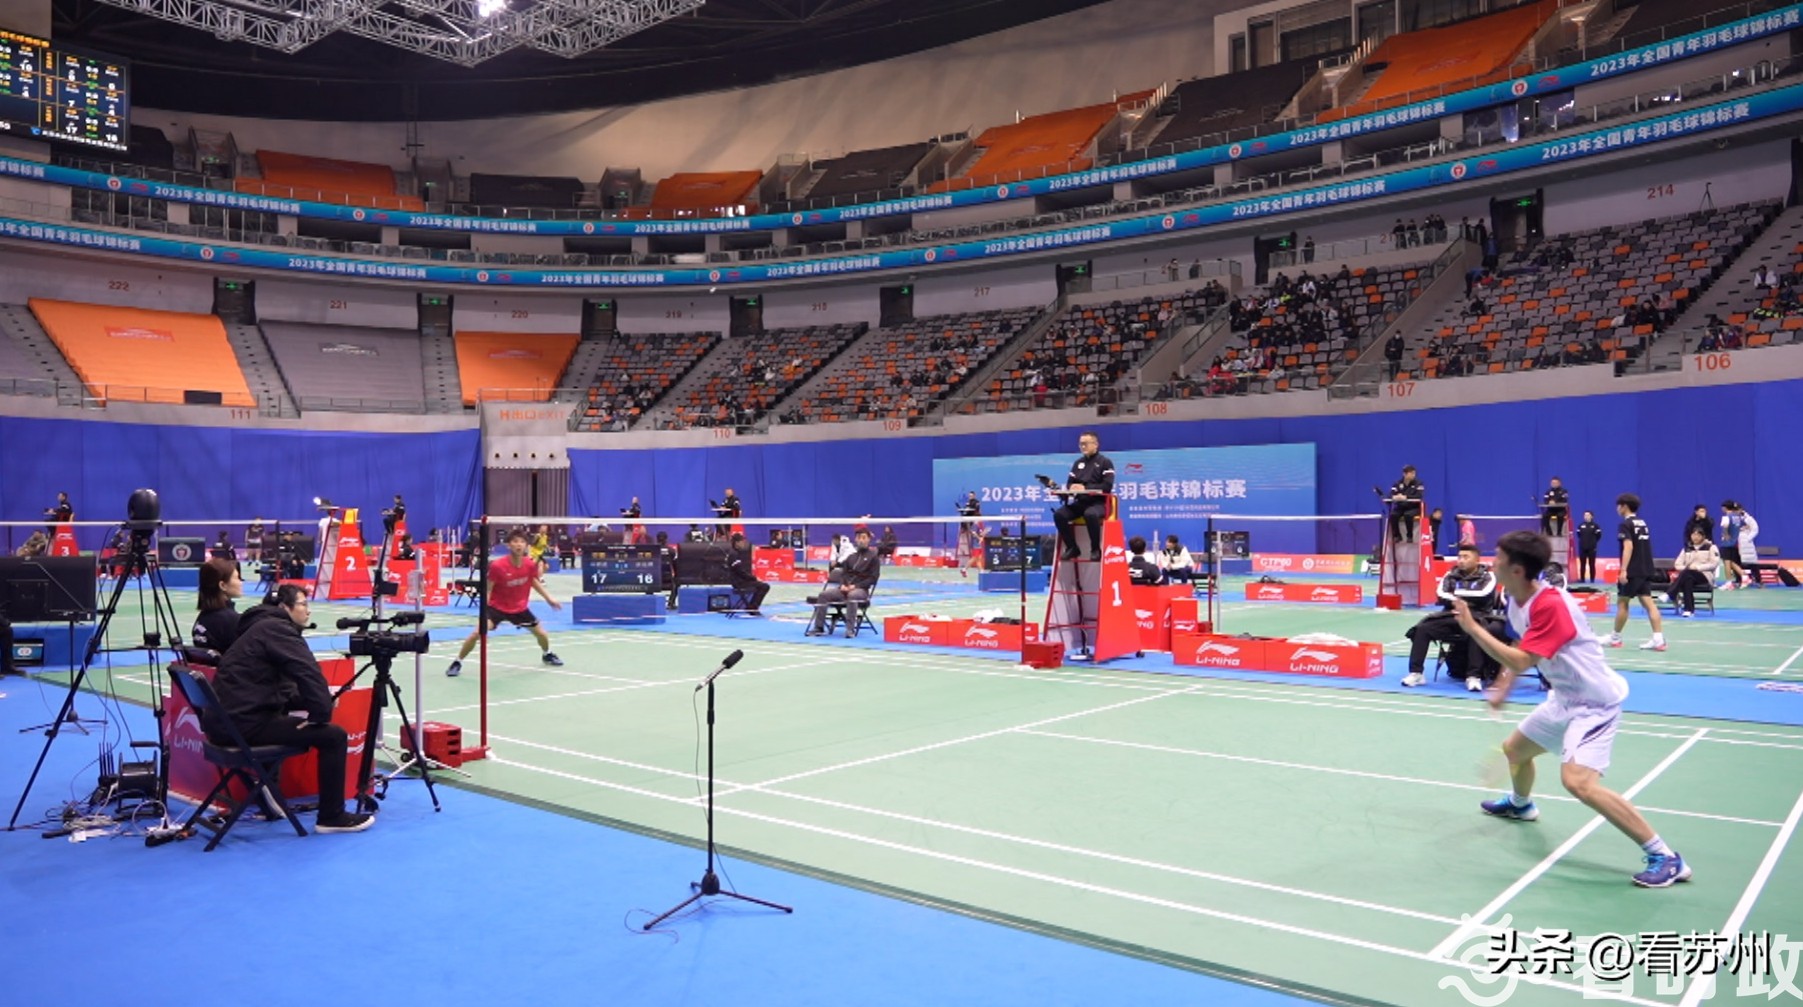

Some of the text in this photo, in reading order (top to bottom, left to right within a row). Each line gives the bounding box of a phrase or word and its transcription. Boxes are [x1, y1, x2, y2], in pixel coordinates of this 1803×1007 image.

[1590, 8, 1800, 77] 2023年全国青年羽毛球锦标赛
[1290, 101, 1446, 145] 2023年全国青年羽毛球锦标赛
[1541, 102, 1750, 160] 2023年全国青年羽毛球锦标赛
[1049, 158, 1177, 189] 2023年全国青年羽毛球锦标赛
[1232, 180, 1386, 216] 2023年全国青年羽毛球锦标赛
[1647, 183, 1675, 199] 214
[154, 186, 300, 213] 2023年全国青年羽毛球锦标赛
[984, 226, 1111, 254] 2023年全国青年羽毛球锦标赛
[288, 258, 427, 279] 2023年全国青年羽毛球锦标赛
[108, 281, 129, 291] 222
[974, 287, 990, 297] 217
[329, 300, 347, 310] 221
[511, 310, 528, 319] 220
[1694, 353, 1731, 371] 106
[1387, 382, 1415, 397] 107
[230, 409, 251, 419] 111
[1145, 403, 1167, 416] 108
[882, 420, 901, 431] 109
[713, 428, 730, 439] 110
[981, 480, 1247, 501] 2023年全羽毛球锦标赛
[345, 556, 356, 571] 2
[1026, 556, 1033, 564] 7
[591, 573, 607, 584] 17
[1111, 580, 1123, 607] 1
[899, 635, 931, 643] LI-NING
[965, 639, 998, 648] LI-NING
[1195, 655, 1241, 667] LI-NING
[1289, 662, 1340, 674] LI-NING
[173, 734, 205, 753] LI-NIN
